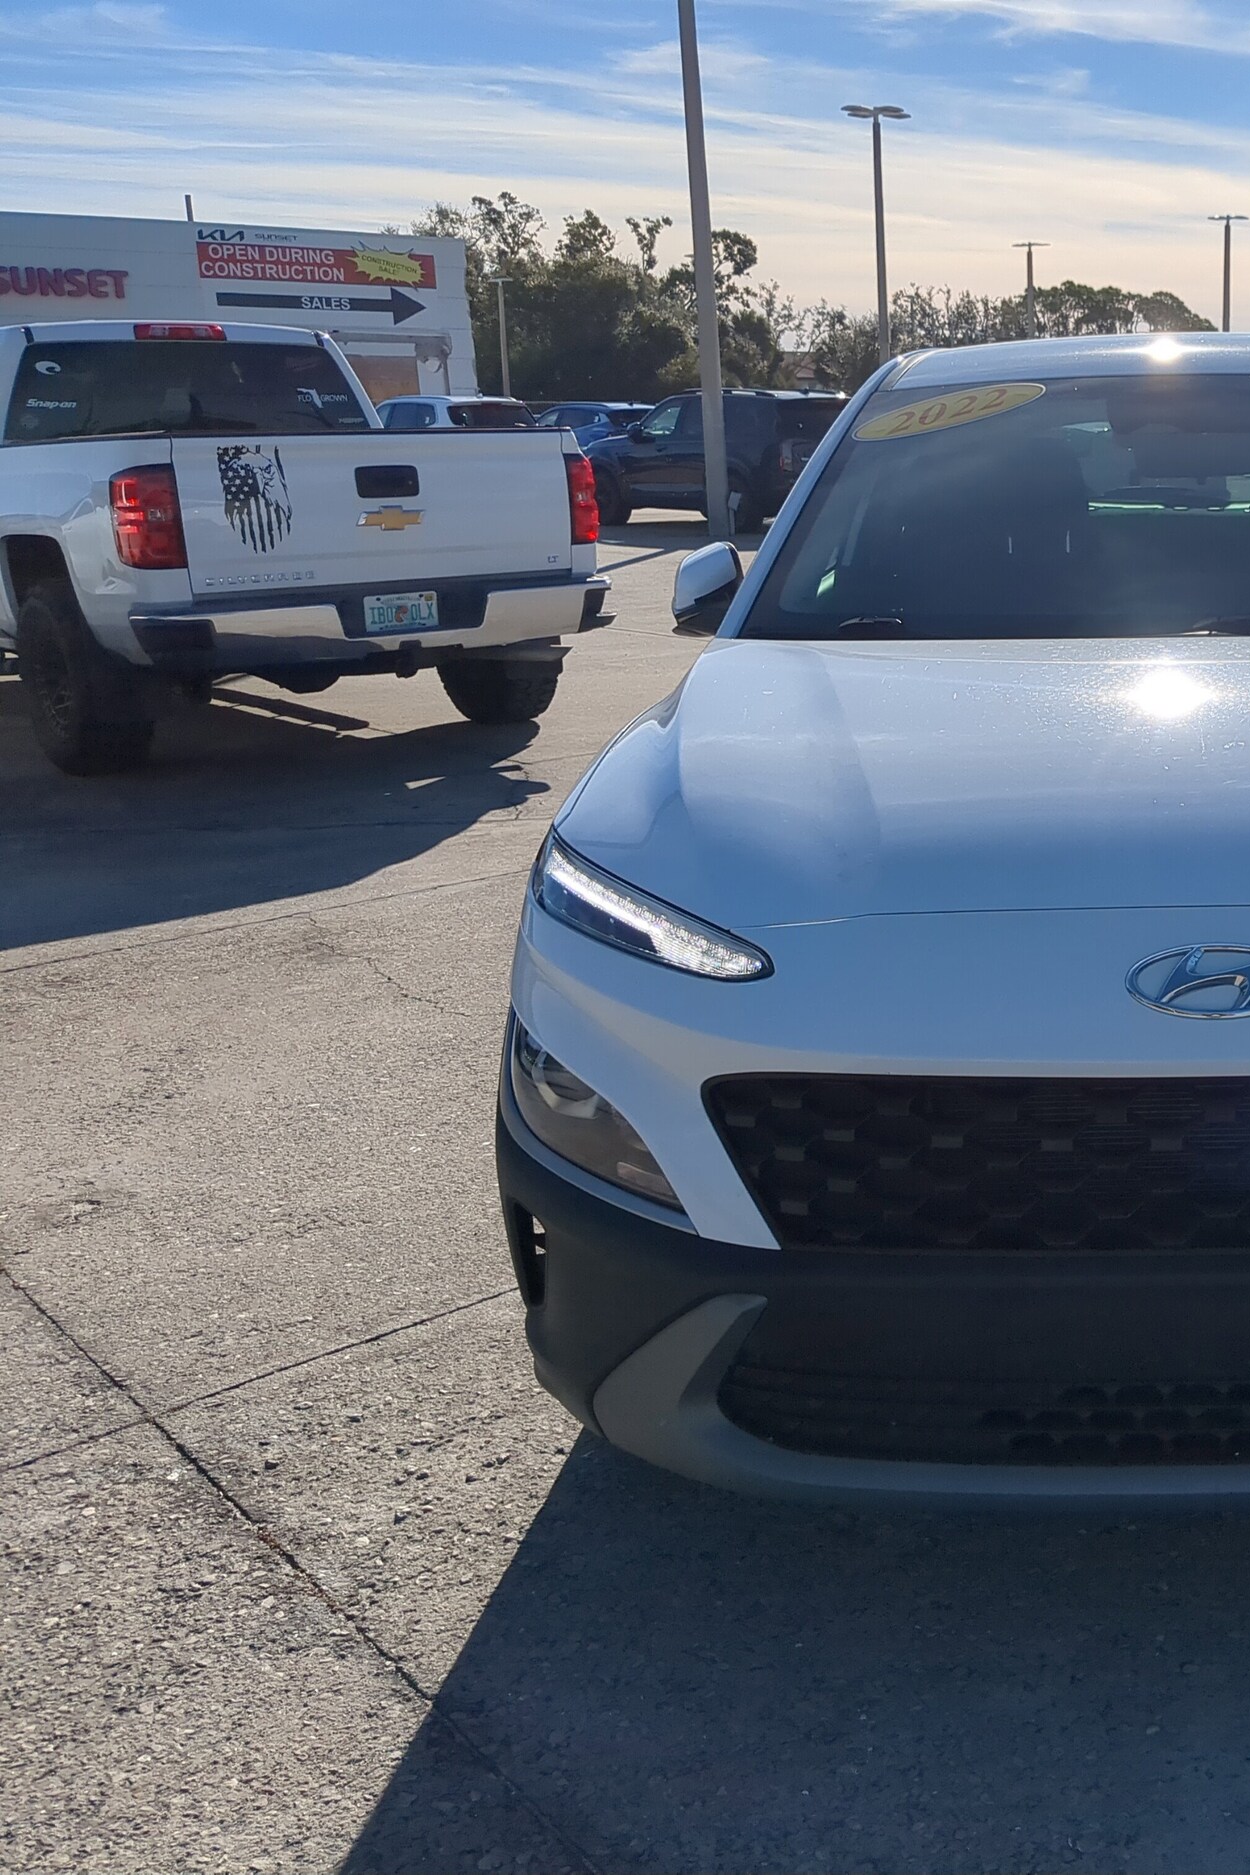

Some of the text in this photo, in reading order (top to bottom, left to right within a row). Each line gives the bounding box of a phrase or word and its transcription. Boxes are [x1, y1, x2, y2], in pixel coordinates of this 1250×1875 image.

[208, 243, 335, 265] OPEN DURING
[361, 254, 418, 274] CONSTRUCTION
[201, 261, 345, 282] CONSTRUCTION
[301, 296, 351, 311] SALES
[320, 394, 348, 402] GROWN
[886, 388, 1009, 436] 2022
